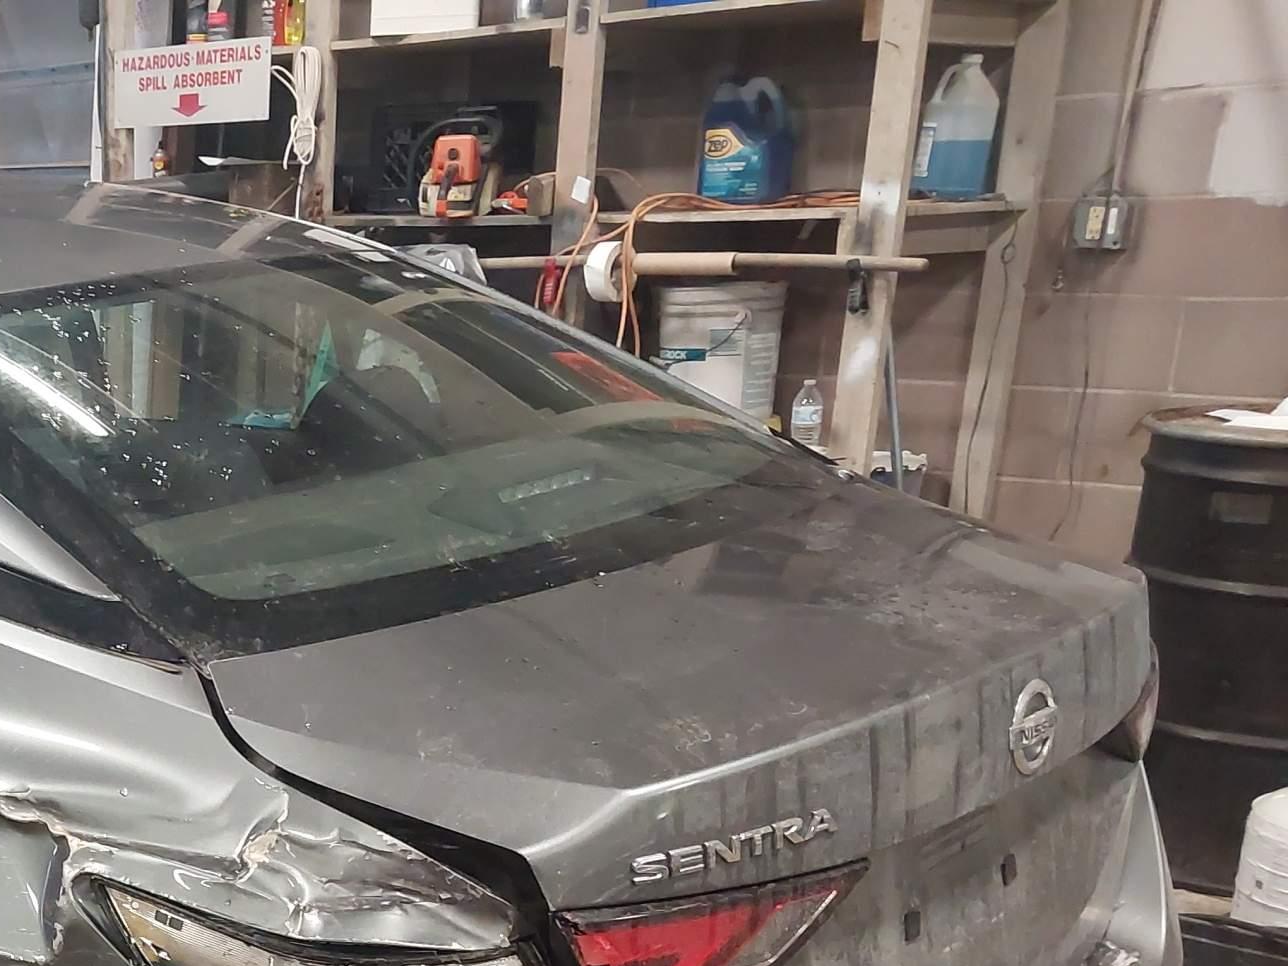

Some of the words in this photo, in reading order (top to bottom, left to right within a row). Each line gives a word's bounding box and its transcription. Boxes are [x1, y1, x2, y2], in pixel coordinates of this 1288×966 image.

[122, 51, 191, 73] HAZARDOUS
[195, 44, 262, 66] MATERIALS
[138, 76, 168, 92] SPILL
[173, 69, 243, 89] ABSORBENT
[631, 808, 839, 885] SENTRA
